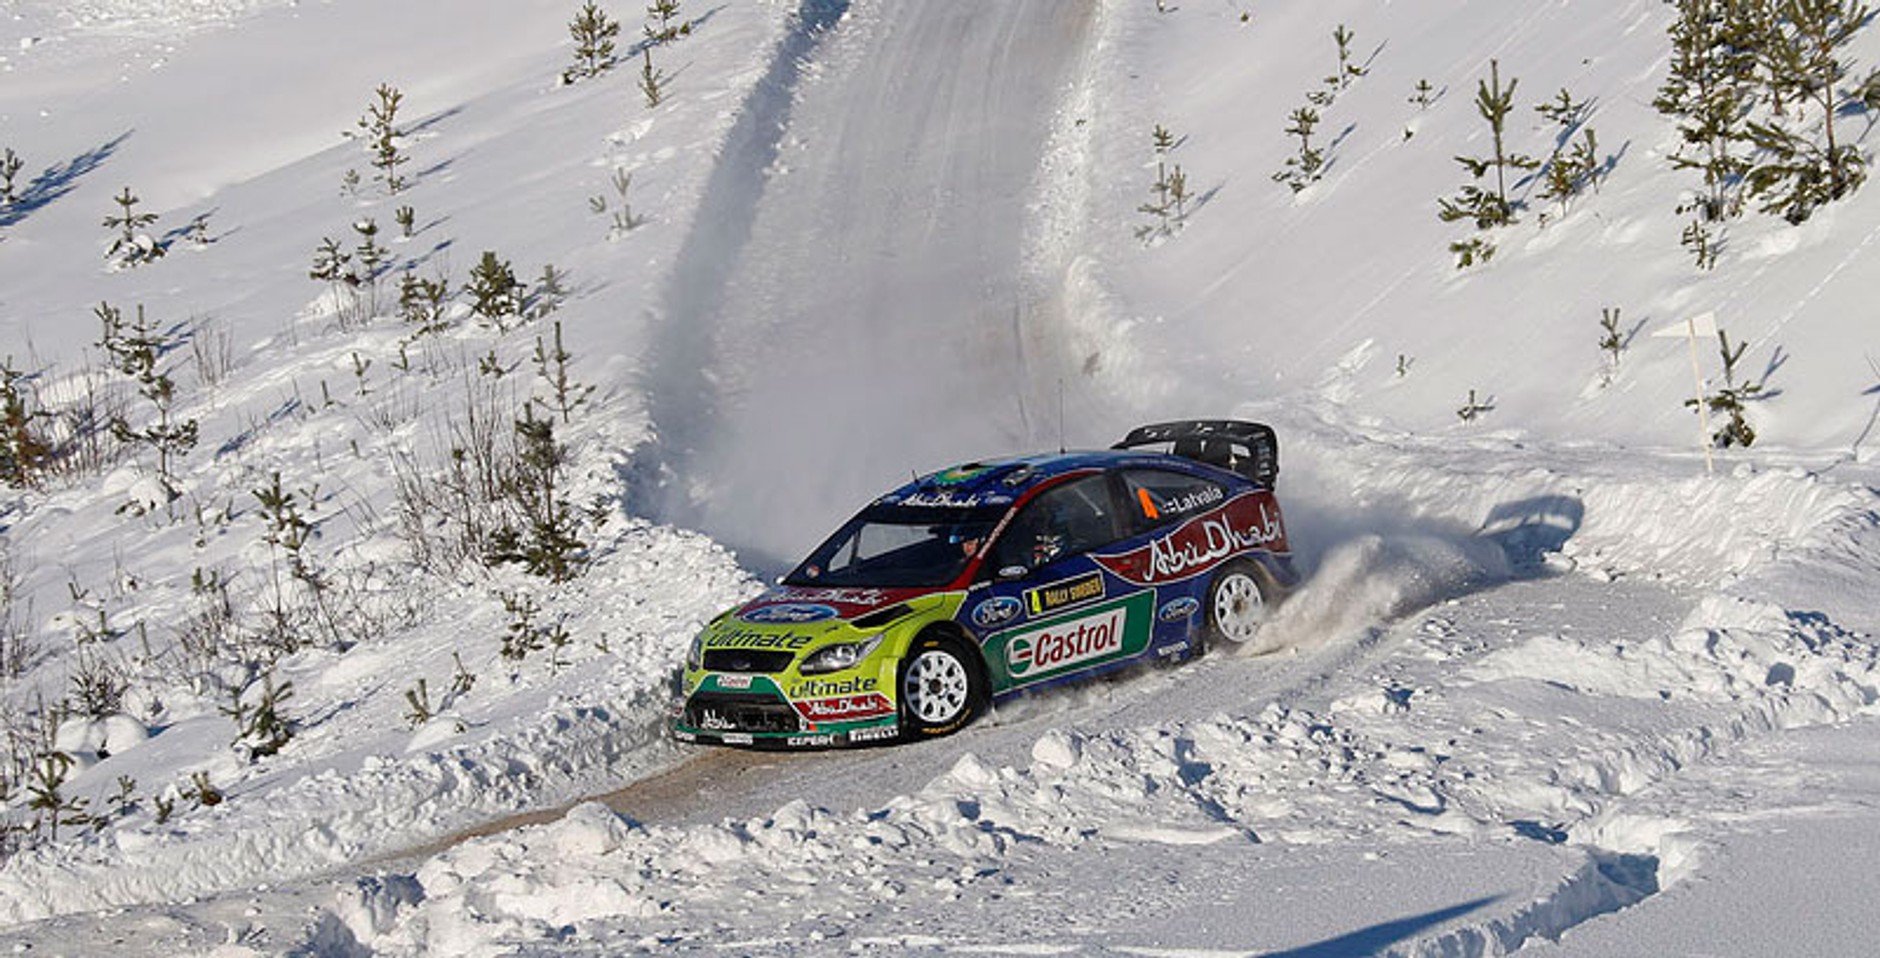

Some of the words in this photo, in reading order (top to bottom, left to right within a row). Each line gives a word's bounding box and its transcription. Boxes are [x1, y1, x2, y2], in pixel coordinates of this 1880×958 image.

[1137, 488, 1160, 520] 4
[1175, 486, 1224, 513] Latvala
[1142, 533, 1212, 581] Abu
[1202, 502, 1283, 559] Dhabi
[1030, 588, 1042, 614] 4
[707, 630, 814, 650] ultimate
[1035, 615, 1119, 666] Castrol
[790, 676, 878, 698] ultimate
